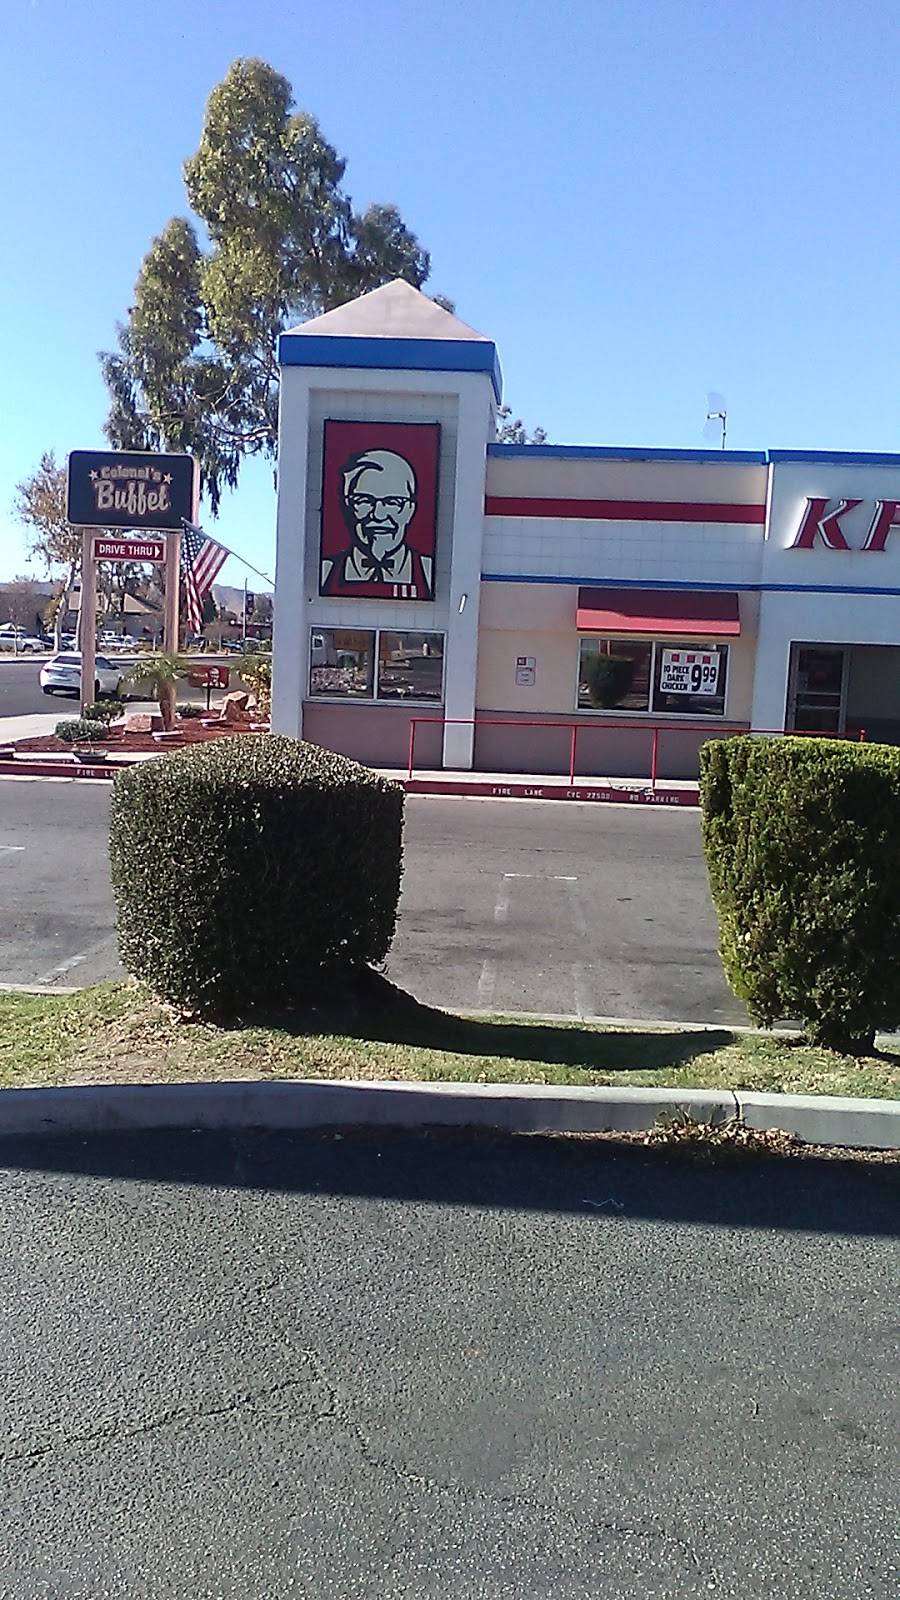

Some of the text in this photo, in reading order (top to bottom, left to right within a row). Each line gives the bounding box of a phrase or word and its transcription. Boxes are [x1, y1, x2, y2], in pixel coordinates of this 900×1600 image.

[101, 465, 161, 482] Colonel's
[94, 480, 168, 515] Buffet
[100, 544, 153, 556] DRIVE THRU
[672, 665, 690, 674] PIECE
[662, 682, 688, 691] CHICKEN
[77, 769, 95, 777] FIRE
[493, 787, 511, 795] FIRE
[645, 795, 679, 803] PARKING
